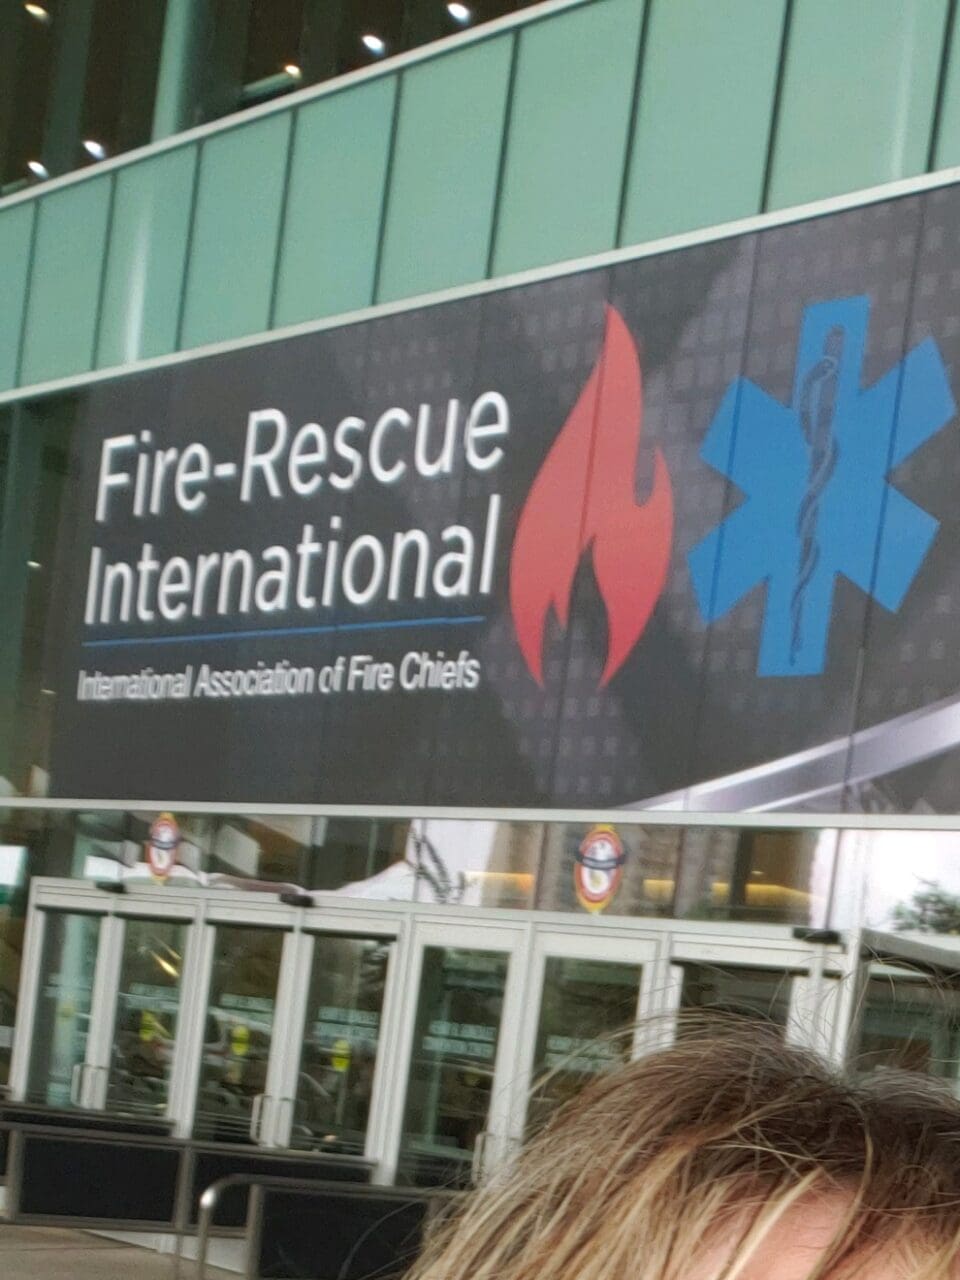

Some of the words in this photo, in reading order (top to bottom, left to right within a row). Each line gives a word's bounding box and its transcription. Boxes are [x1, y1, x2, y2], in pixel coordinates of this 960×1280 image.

[95, 391, 510, 522] Fire-Rescue
[84, 493, 501, 625] International
[76, 663, 194, 701] International
[193, 658, 316, 698] Association
[318, 655, 347, 694] of
[347, 654, 395, 692] Fire
[399, 649, 481, 691] Chiefs
